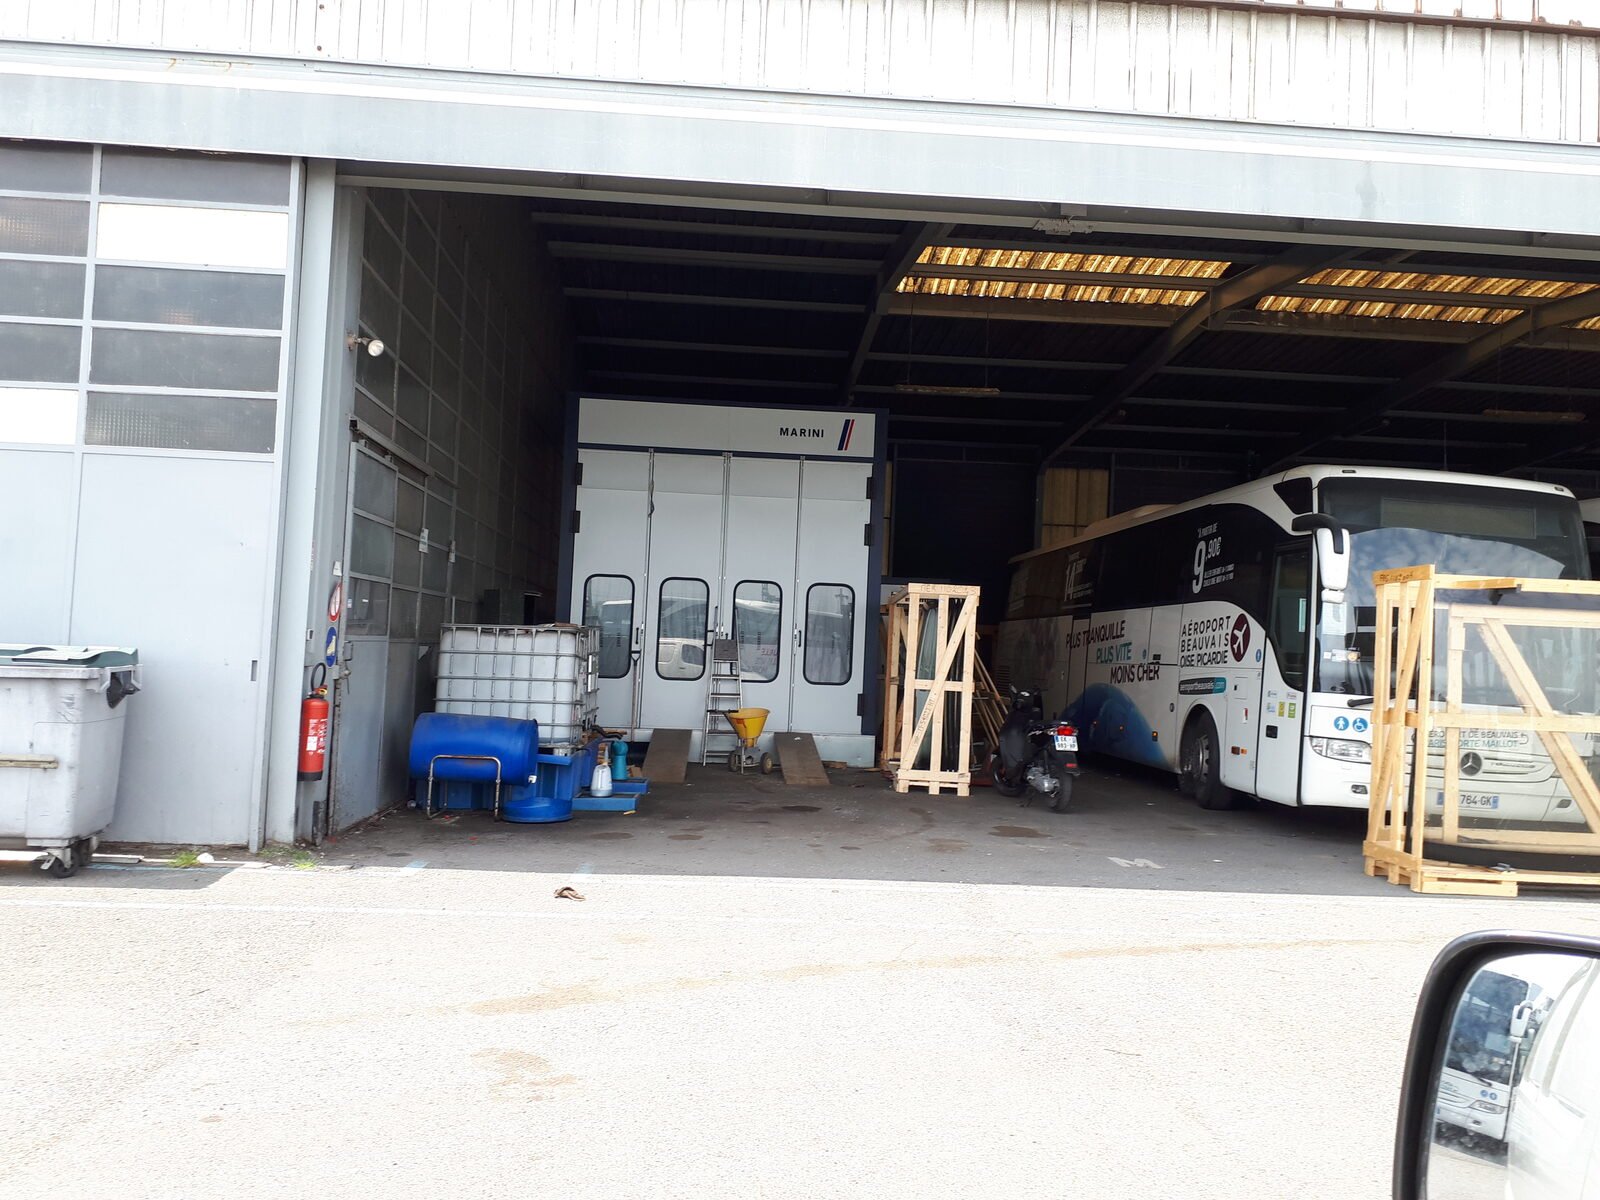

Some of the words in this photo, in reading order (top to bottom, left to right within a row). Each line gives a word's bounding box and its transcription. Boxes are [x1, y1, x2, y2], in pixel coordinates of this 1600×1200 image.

[780, 427, 824, 438] MARINI
[1065, 631, 1082, 648] PLUS
[1082, 619, 1126, 646] TRANQUILLE
[1181, 615, 1231, 637] AÉROPORT
[1096, 645, 1114, 664] PLUS
[1115, 641, 1132, 661] VITE
[1180, 632, 1230, 653] BEAUVAIS
[1180, 654, 1195, 668] OISE
[1196, 649, 1229, 667] PICARDIE
[1109, 664, 1135, 684] MOINS
[1136, 664, 1160, 681] CHER
[1482, 739, 1519, 748] MAILLOT
